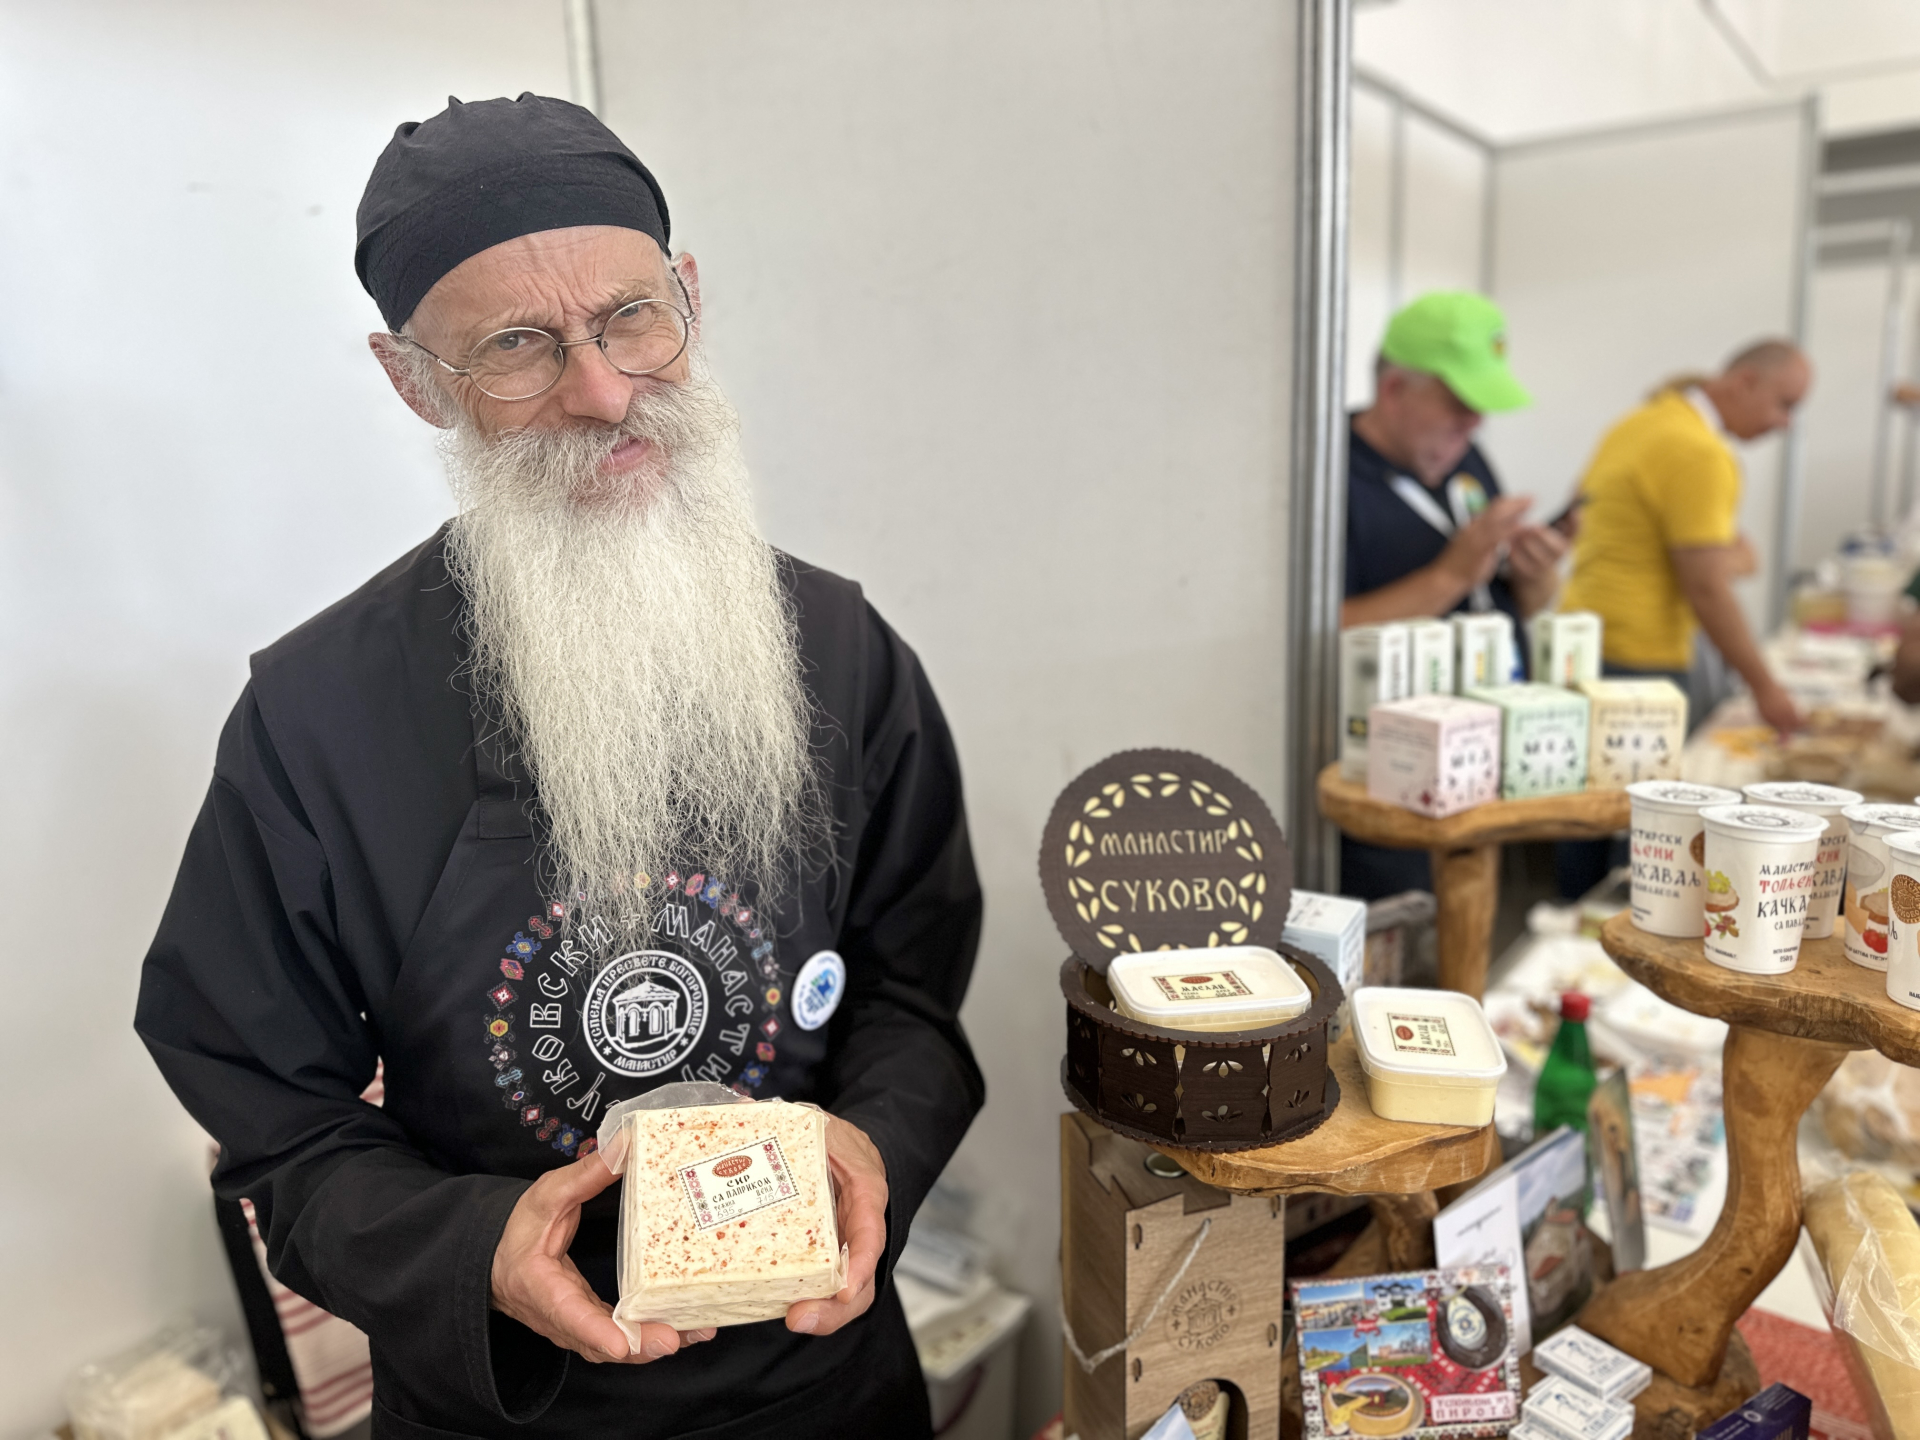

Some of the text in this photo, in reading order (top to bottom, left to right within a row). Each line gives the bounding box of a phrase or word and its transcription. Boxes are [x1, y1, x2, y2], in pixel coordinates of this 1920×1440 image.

[1100, 829, 1228, 856] МАНАСТИР
[1632, 828, 1682, 846] СТИРСКИ
[1100, 877, 1238, 913] СУКОВО
[668, 960, 703, 1036] БОГОРОДИЦЕ
[530, 903, 754, 1122] УКОВСКИ МАНАСТИ
[613, 1049, 677, 1071] МАНАСТИР
[712, 1177, 771, 1203] СА ПАПРИКОМ
[726, 1174, 750, 1187] СИР
